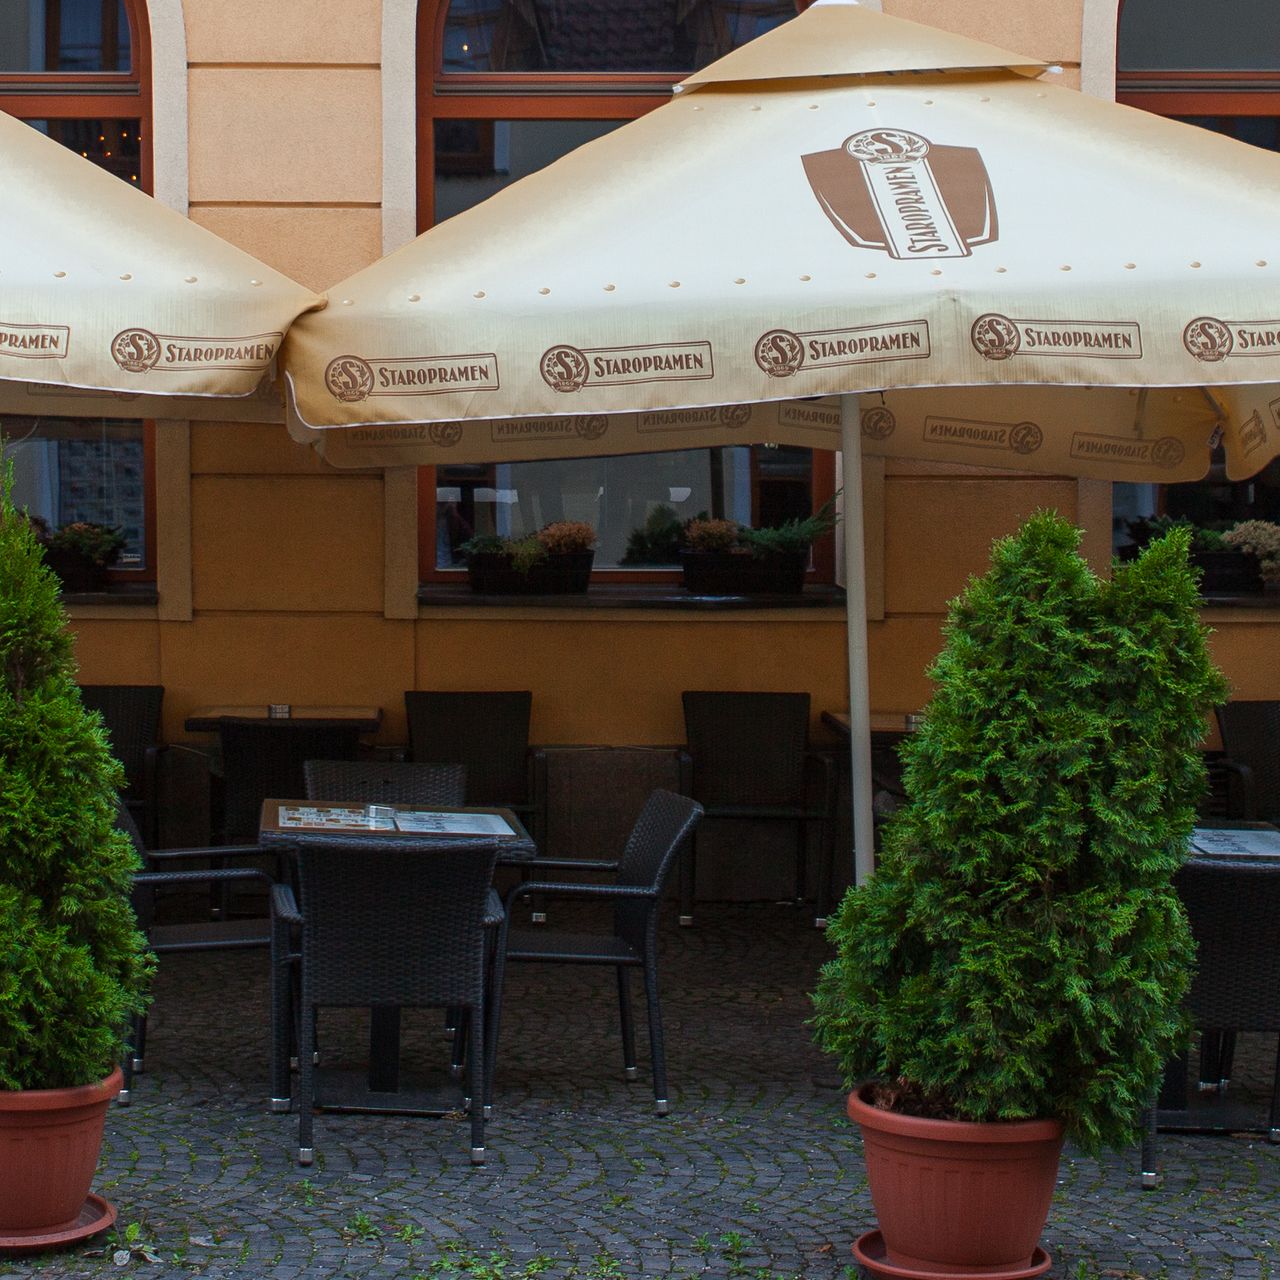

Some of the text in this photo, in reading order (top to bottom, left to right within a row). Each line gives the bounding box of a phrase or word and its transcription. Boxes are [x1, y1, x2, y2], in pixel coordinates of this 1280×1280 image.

[882, 166, 950, 253] STAROPRAMEN
[809, 332, 921, 361] STAROPRAMEN
[1024, 327, 1132, 350] STAROPRAMEN
[165, 343, 275, 363] STAROPRAMEN
[378, 364, 489, 387] STAROPRAMEN
[594, 353, 704, 377] STAROPRAMEN
